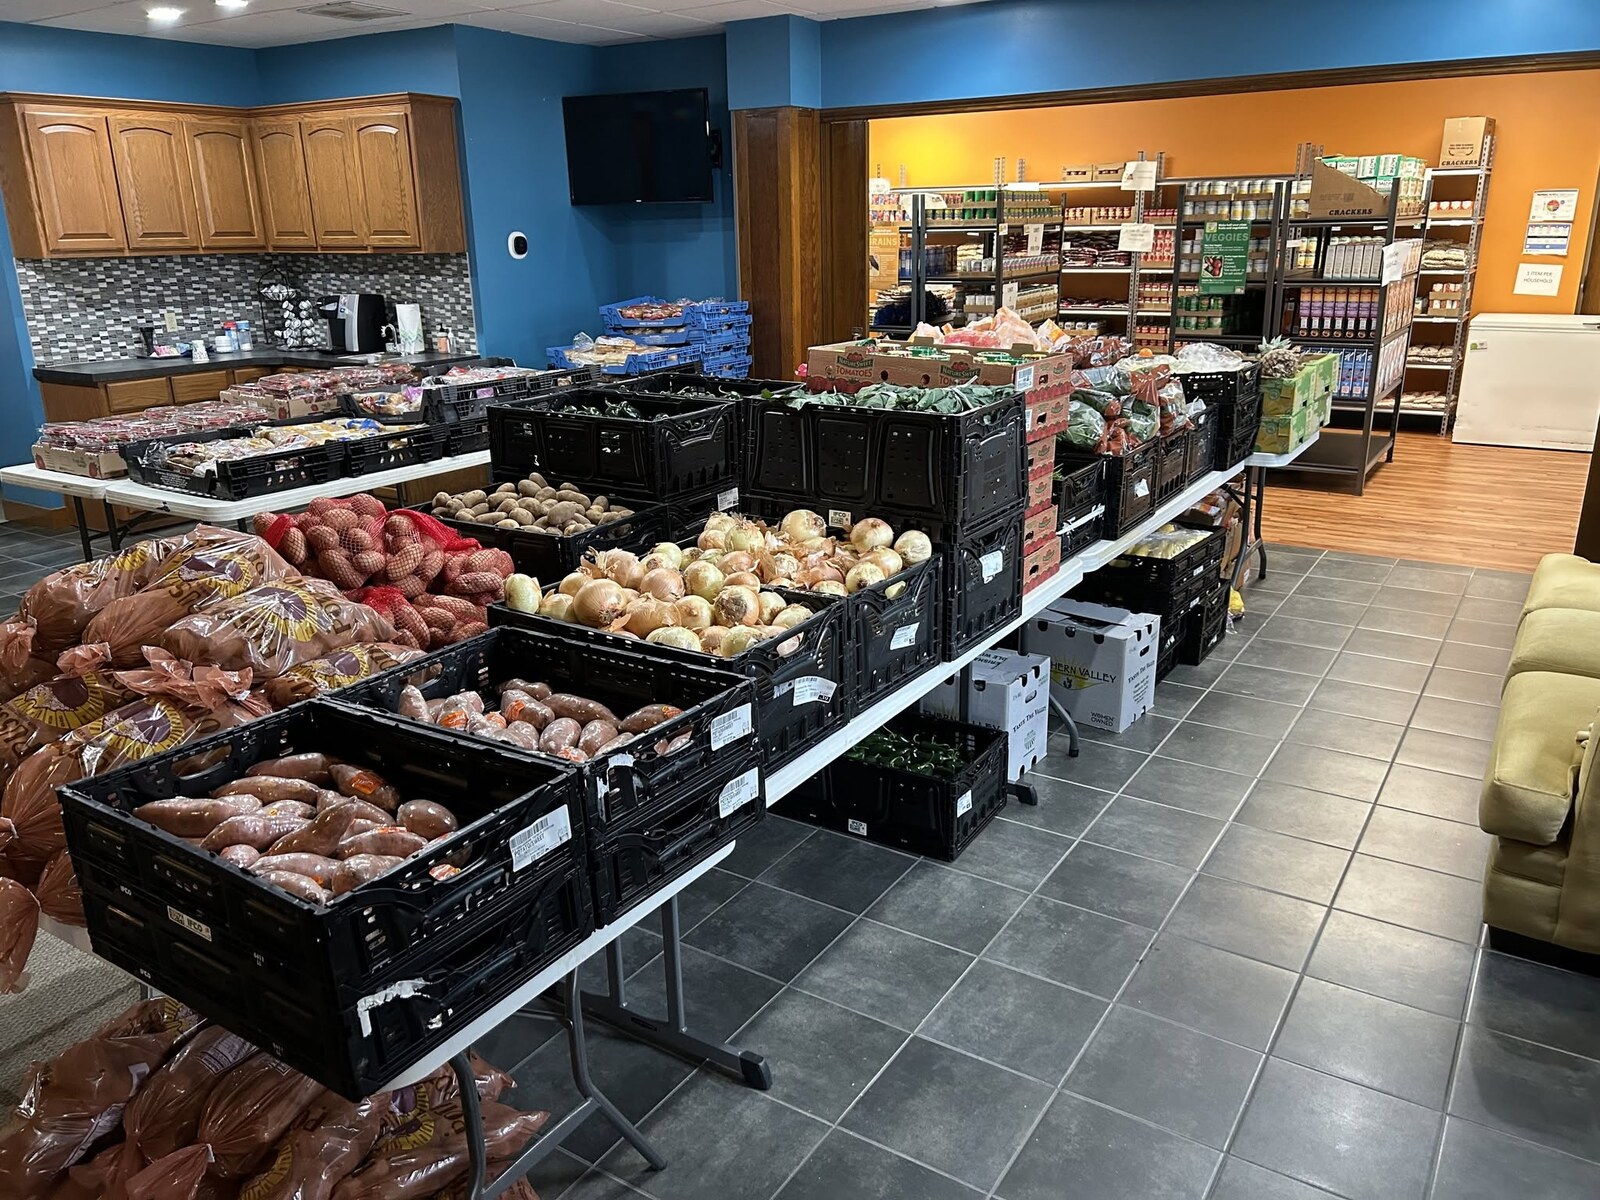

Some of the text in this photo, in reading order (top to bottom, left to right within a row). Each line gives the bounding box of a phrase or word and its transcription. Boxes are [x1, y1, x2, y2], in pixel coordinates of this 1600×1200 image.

[1328, 208, 1373, 216] CRACKERS
[869, 237, 898, 247] RAINS
[1205, 233, 1249, 242] VEGGIES
[836, 366, 874, 378] TOMATOES
[1078, 666, 1117, 684] VALLEY
